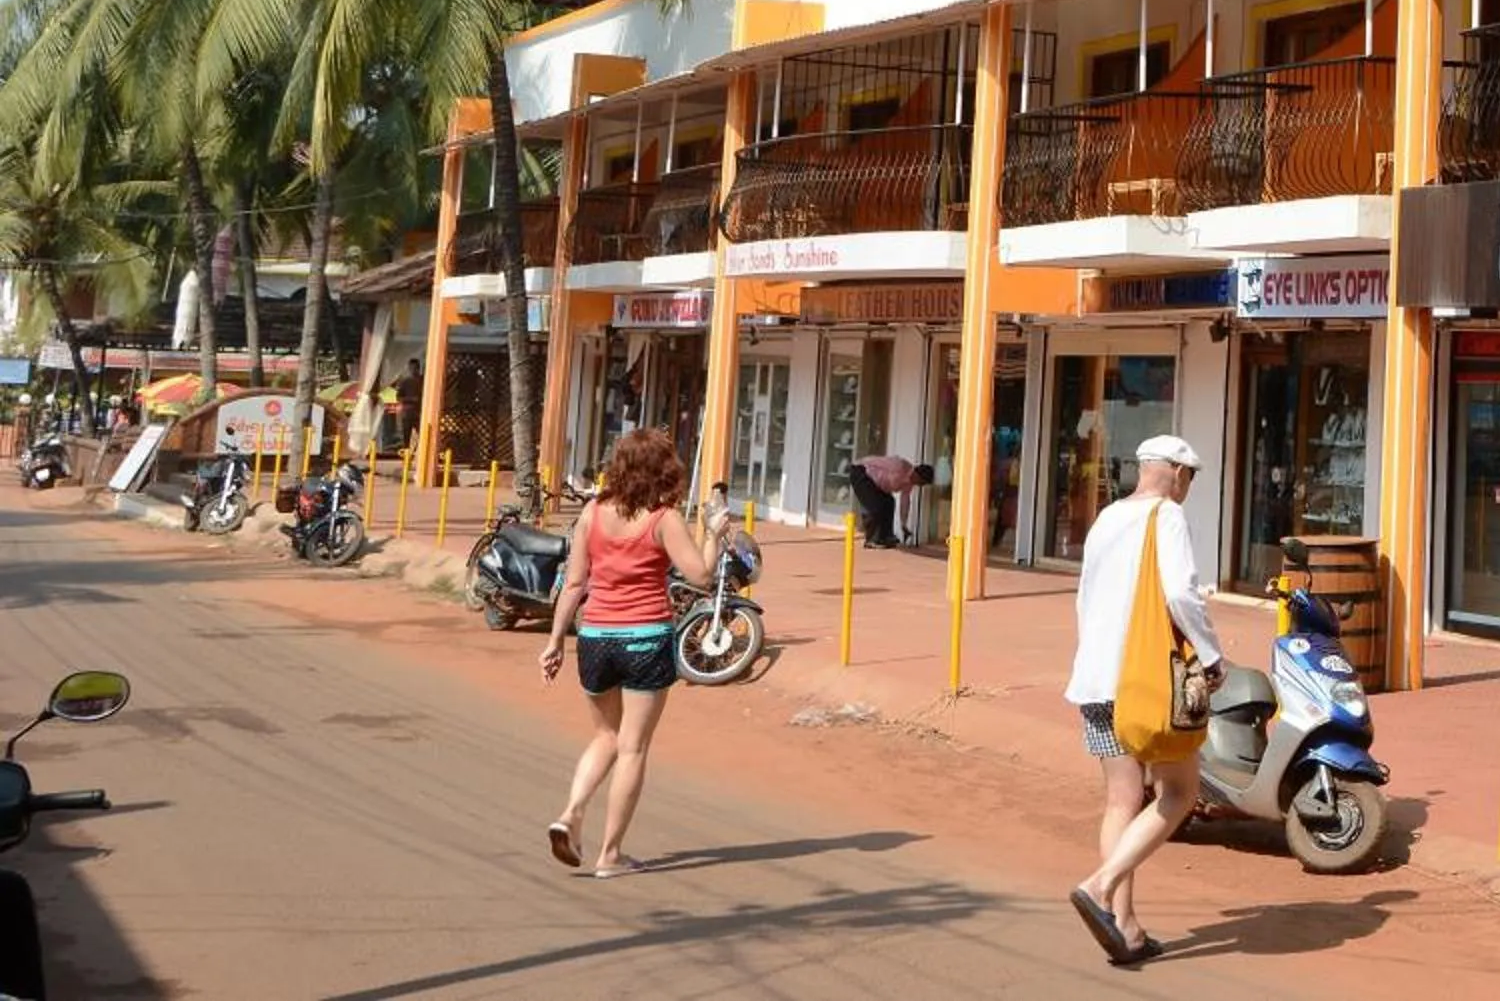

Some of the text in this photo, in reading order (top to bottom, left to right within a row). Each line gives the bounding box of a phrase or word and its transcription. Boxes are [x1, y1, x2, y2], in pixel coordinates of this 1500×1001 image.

[783, 241, 839, 269] Sunshine
[837, 287, 960, 319] LEATHER HOUS
[1263, 272, 1293, 306] EYE
[1295, 271, 1341, 306] LINKS
